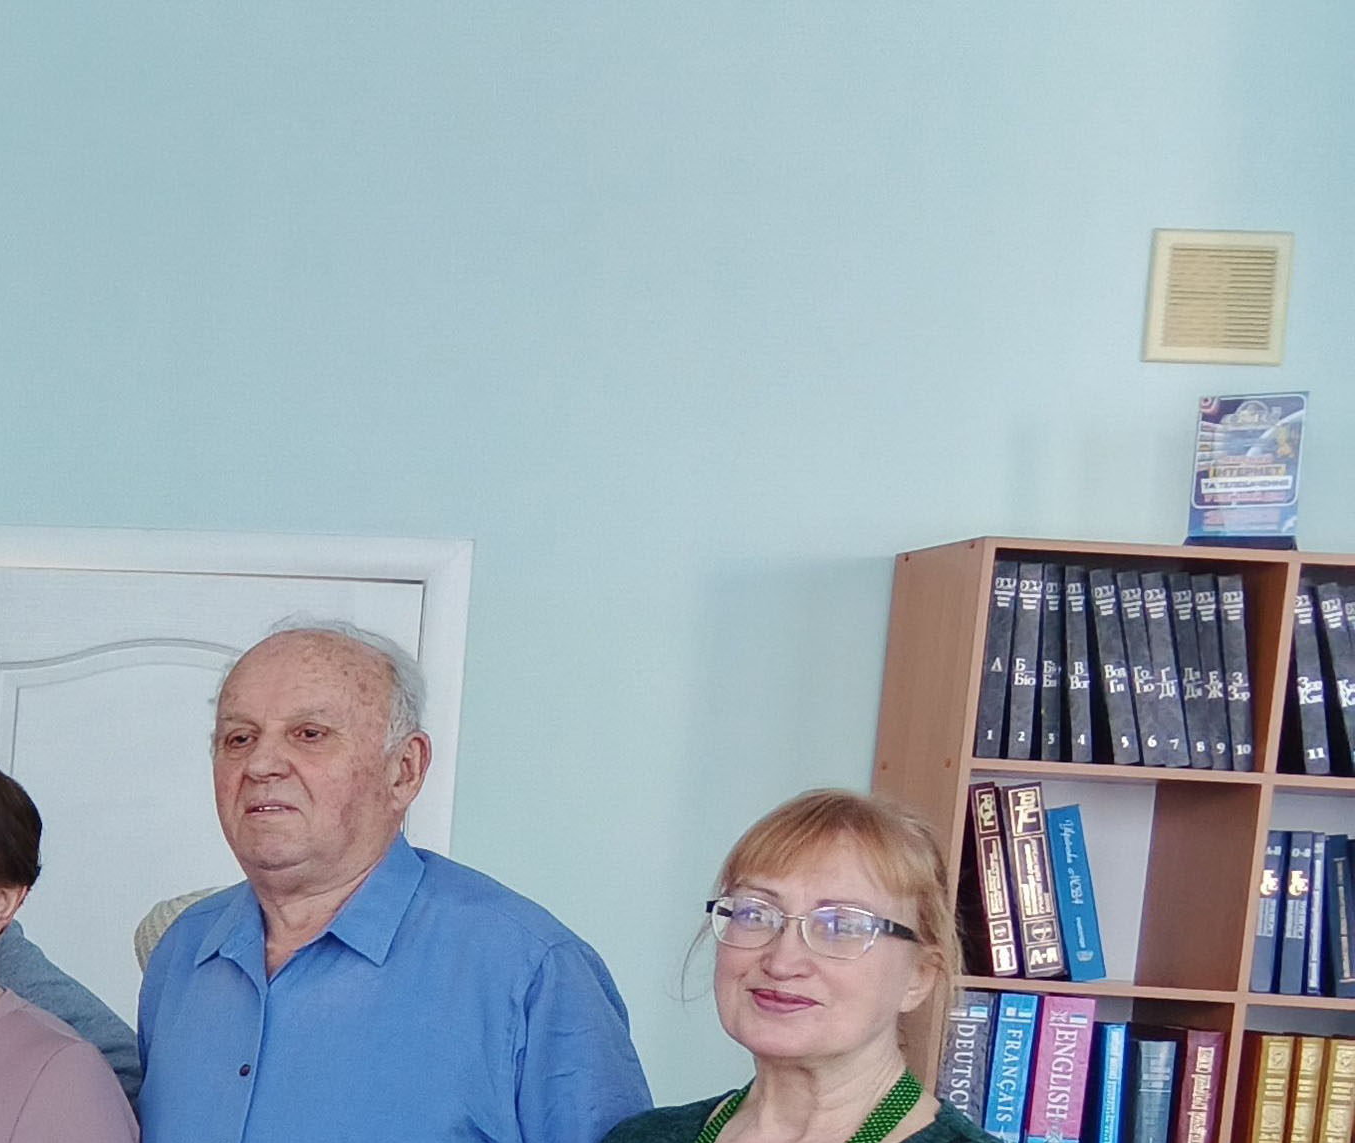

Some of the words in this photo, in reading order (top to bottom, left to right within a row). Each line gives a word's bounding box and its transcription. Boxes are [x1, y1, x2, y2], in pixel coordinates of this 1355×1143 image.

[1018, 731, 1026, 741] 2
[1077, 734, 1086, 745] 4
[1147, 735, 1158, 747] 6
[1169, 738, 1180, 750] 7
[1216, 743, 1226, 754] 9
[1236, 744, 1251, 755] 10
[1307, 747, 1325, 760] 11
[996, 1029, 1023, 1123] FRANÇAIS
[1046, 1026, 1078, 1121] ENGLISH
